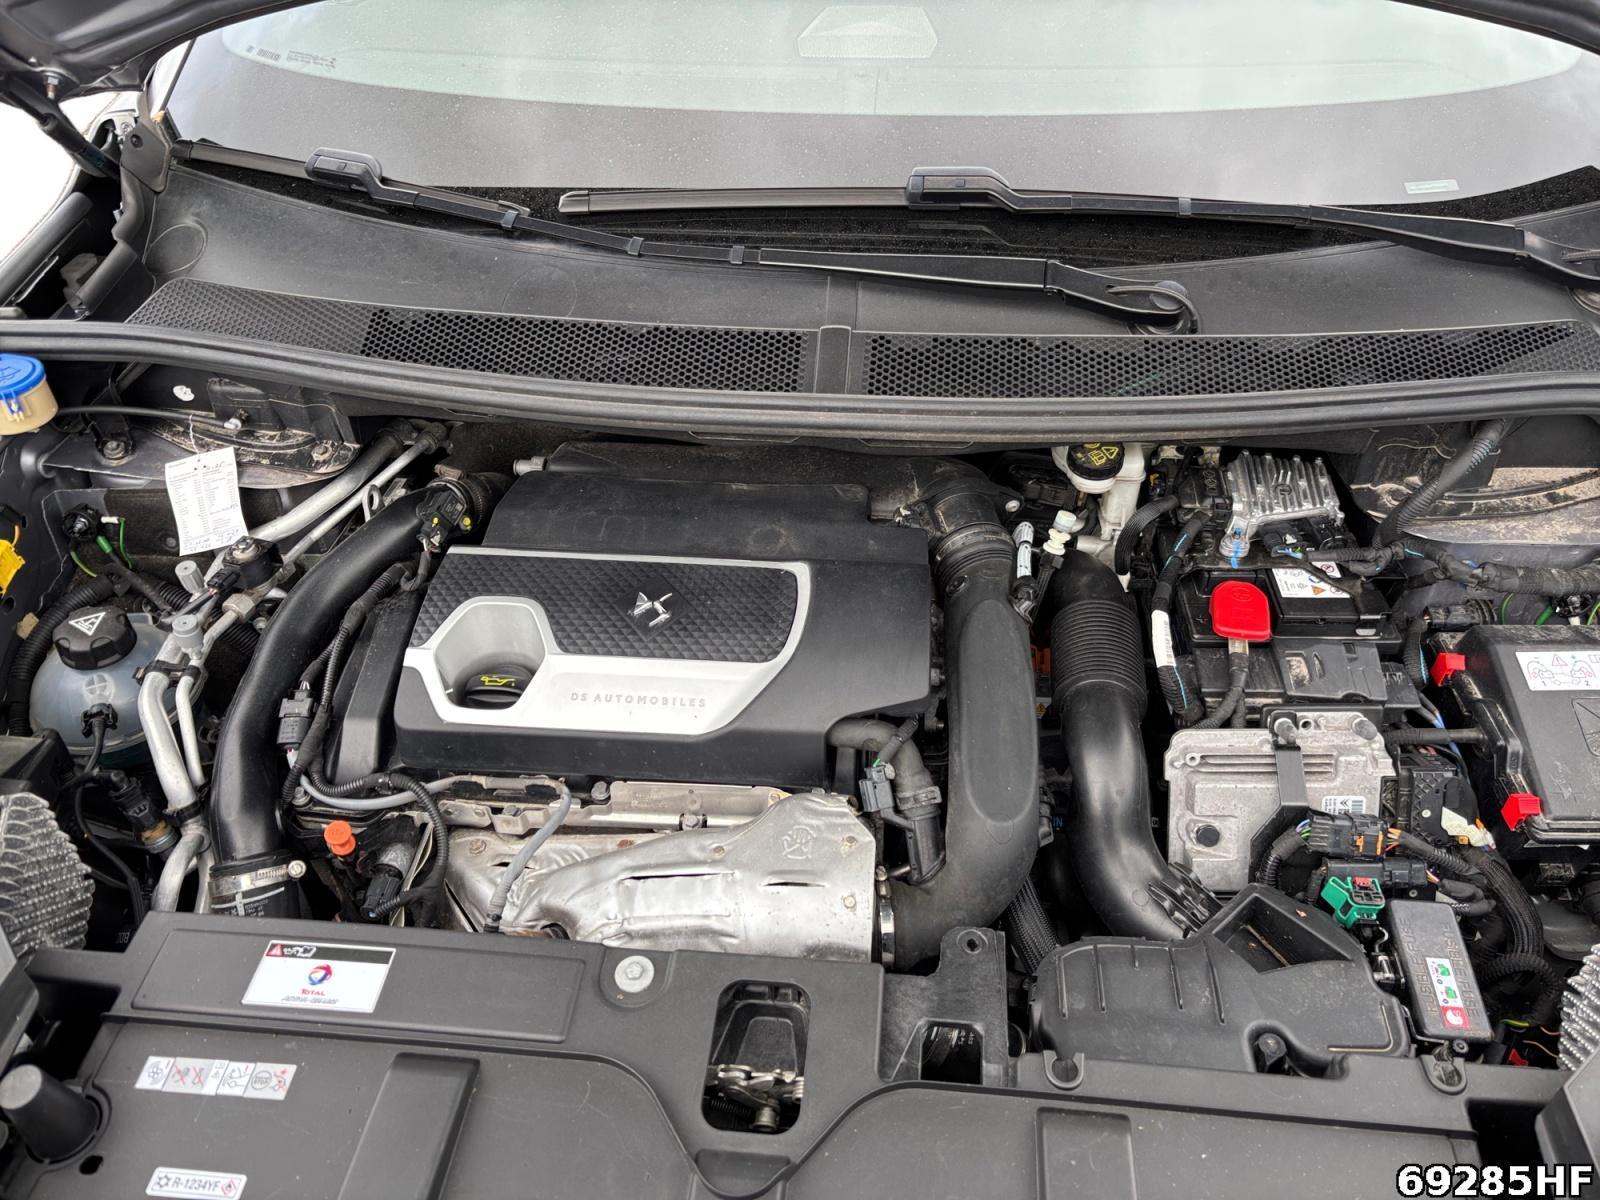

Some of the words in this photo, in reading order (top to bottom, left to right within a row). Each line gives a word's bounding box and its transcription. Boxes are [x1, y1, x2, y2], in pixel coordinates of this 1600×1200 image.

[570, 692, 588, 702] DS
[593, 693, 706, 708] AUTOMOBILES
[301, 988, 326, 997] TOTAL
[171, 1176, 221, 1192] R-1234YF
